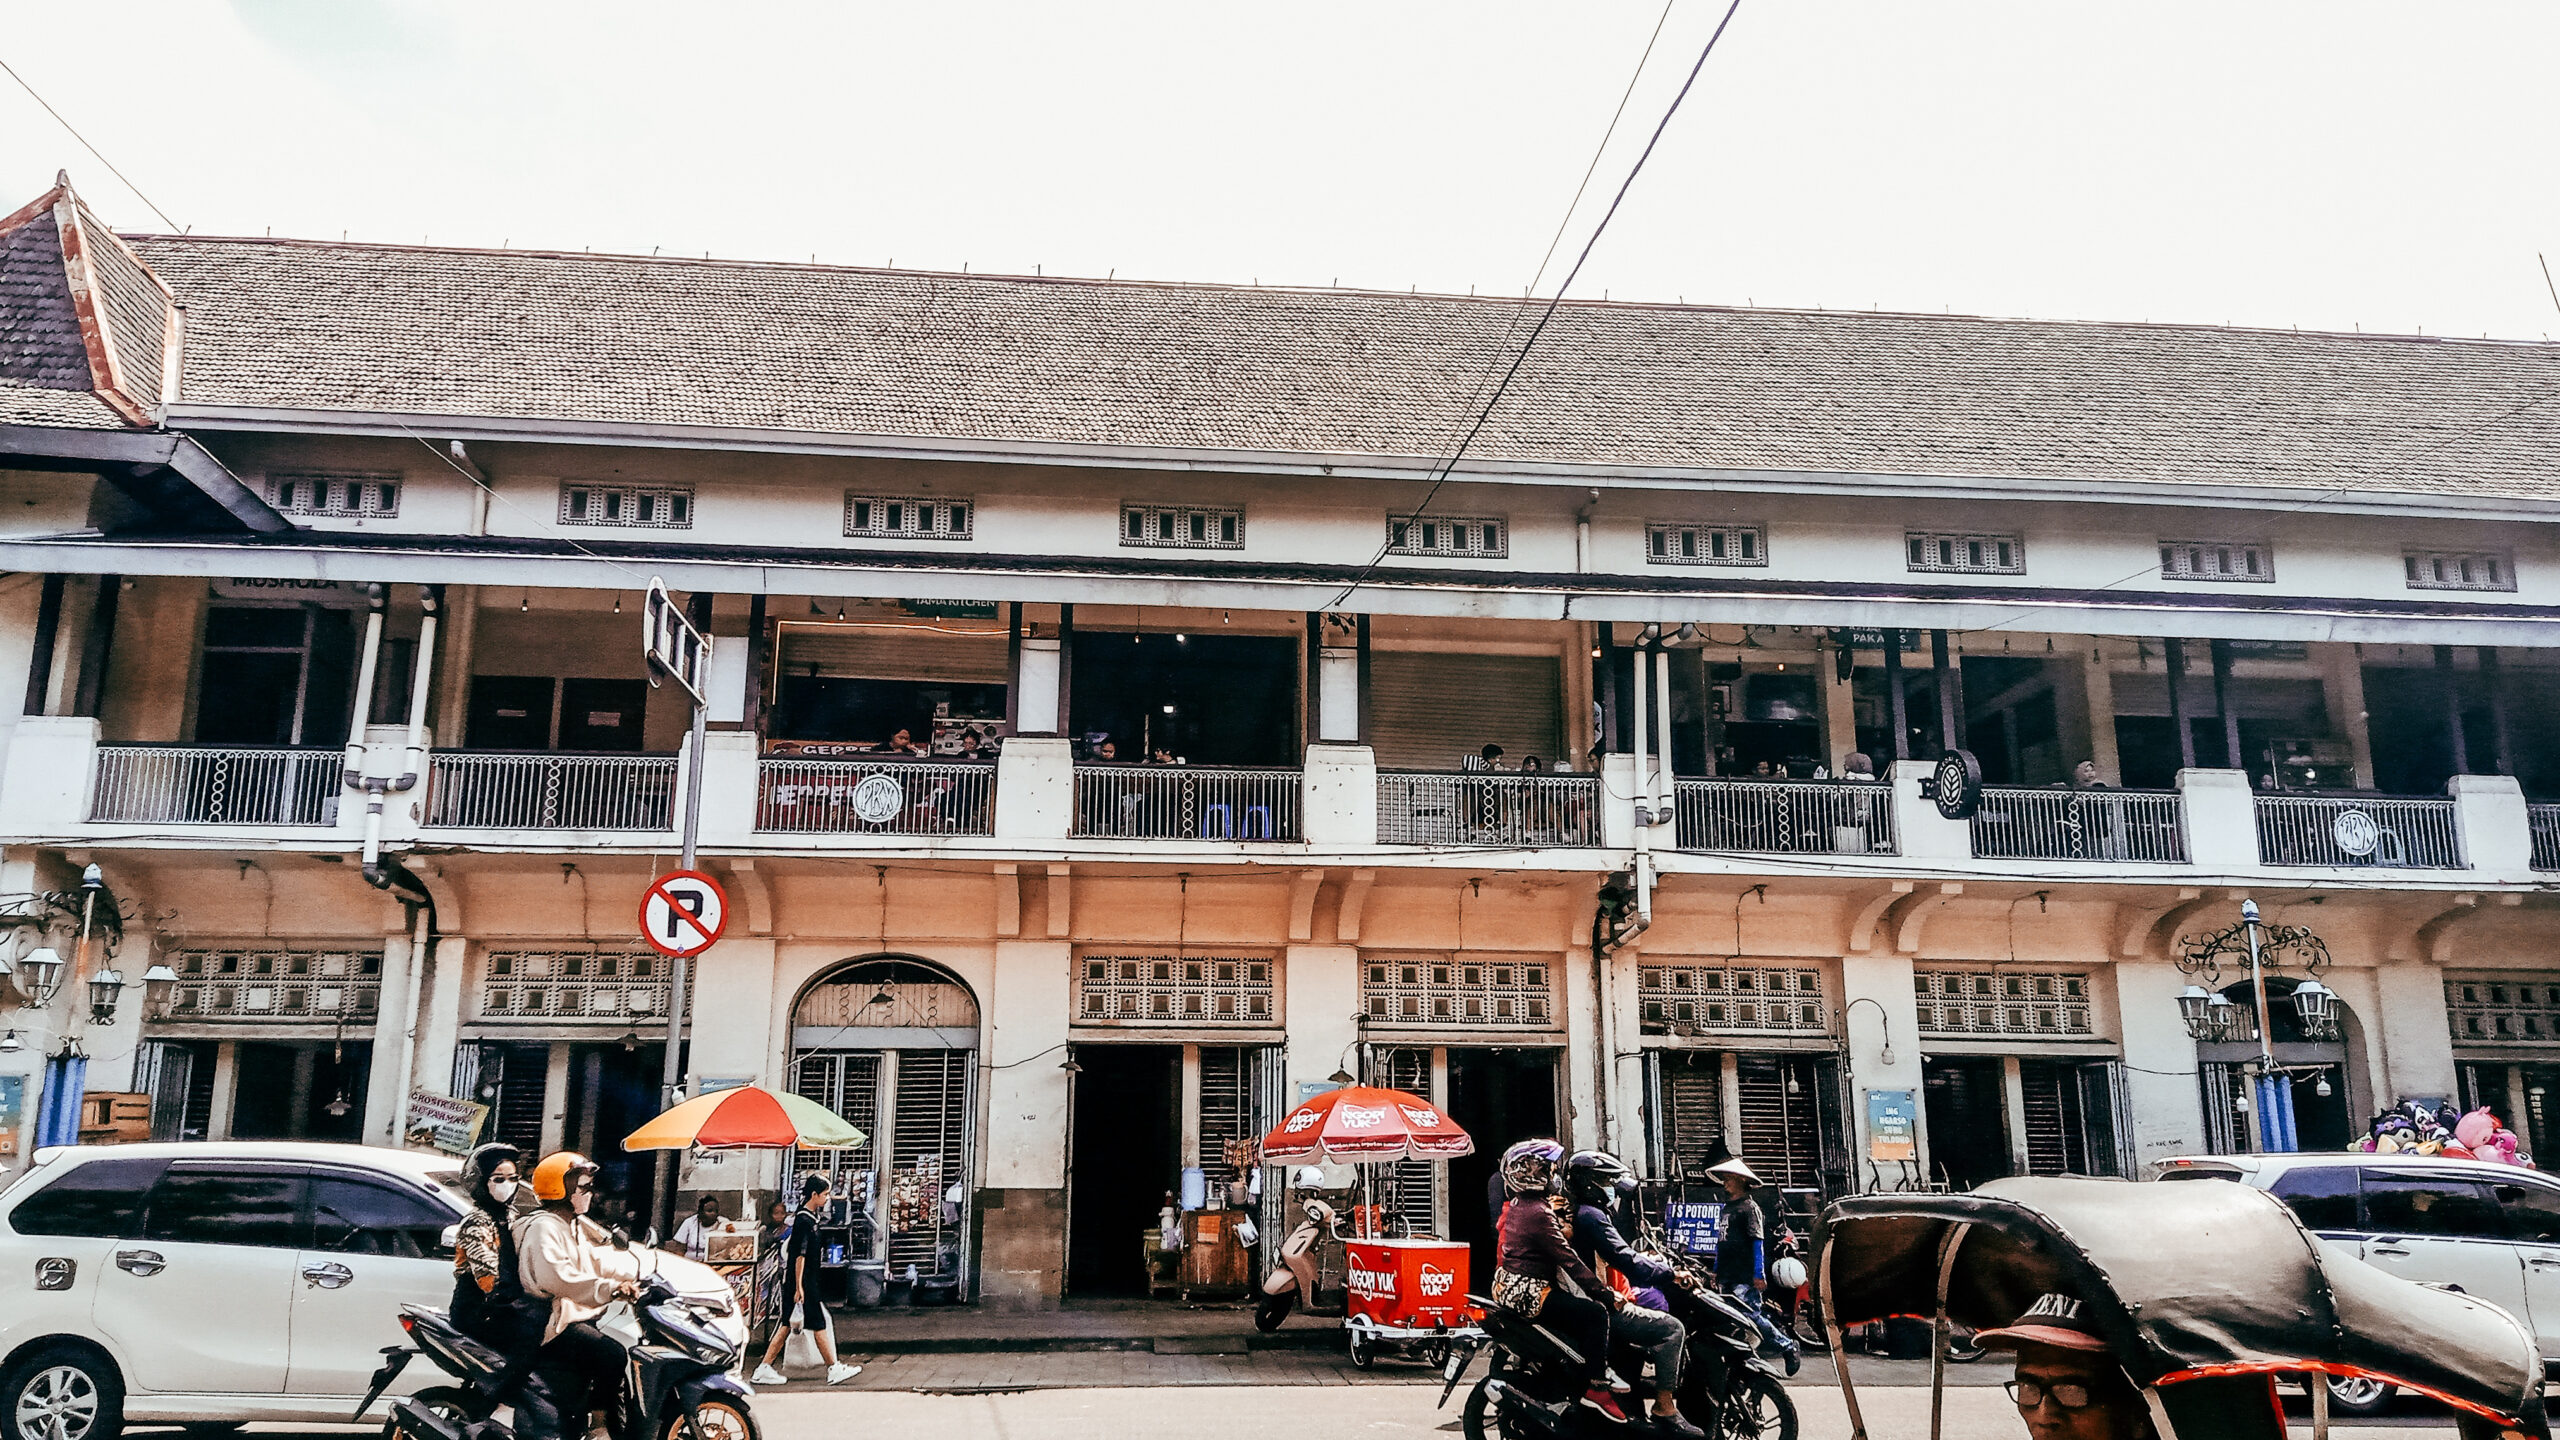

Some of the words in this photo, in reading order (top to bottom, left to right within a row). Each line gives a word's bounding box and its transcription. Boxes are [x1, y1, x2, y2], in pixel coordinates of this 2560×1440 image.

[667, 890, 704, 938] P
[411, 1092, 447, 1109] GROSIR
[1341, 1108, 1385, 1120] NGOPI
[1343, 1118, 1373, 1129] YUK
[1685, 1205, 1720, 1219] POTONG
[1348, 1269, 1375, 1290] NGOPI
[1376, 1271, 1396, 1293] YUK
[1420, 1272, 1454, 1285] NGOPI
[1421, 1284, 1443, 1296] YUK
